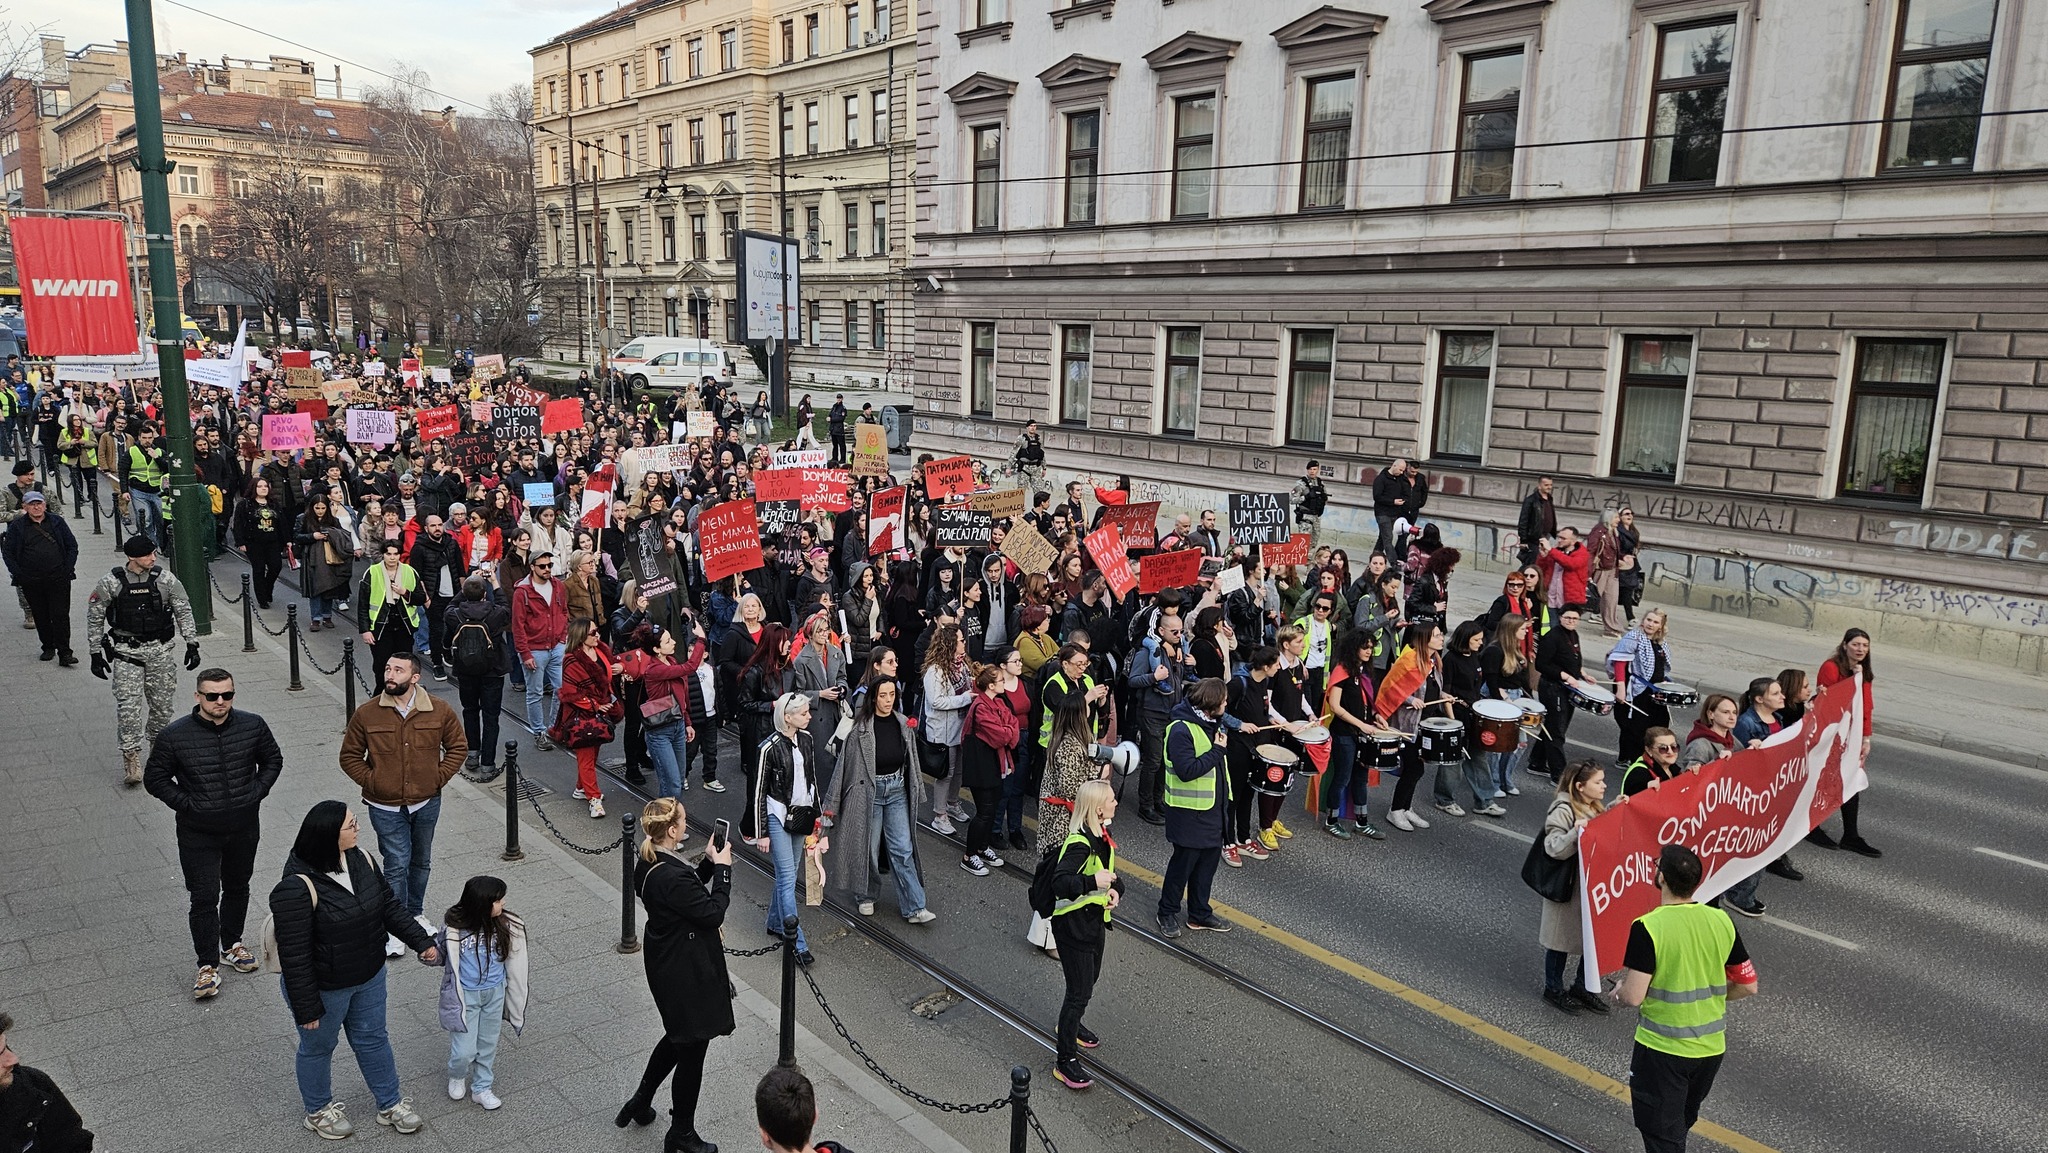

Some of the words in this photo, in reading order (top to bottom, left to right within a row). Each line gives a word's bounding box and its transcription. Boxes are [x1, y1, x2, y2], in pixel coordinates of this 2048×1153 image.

[493, 407, 538, 418] ODMOR
[505, 418, 520, 426] JE
[495, 426, 537, 438] OTPOR
[769, 480, 783, 488] TO
[816, 483, 829, 493] SU
[760, 488, 791, 499] LJUBAV
[777, 501, 788, 511] JE
[1240, 494, 1279, 509] PLATA
[1234, 508, 1285, 525] UMJESTO
[703, 532, 718, 547] JE
[722, 524, 754, 541] MAMA
[1087, 529, 1110, 555] SAM
[1592, 852, 1653, 916] BOSNE
